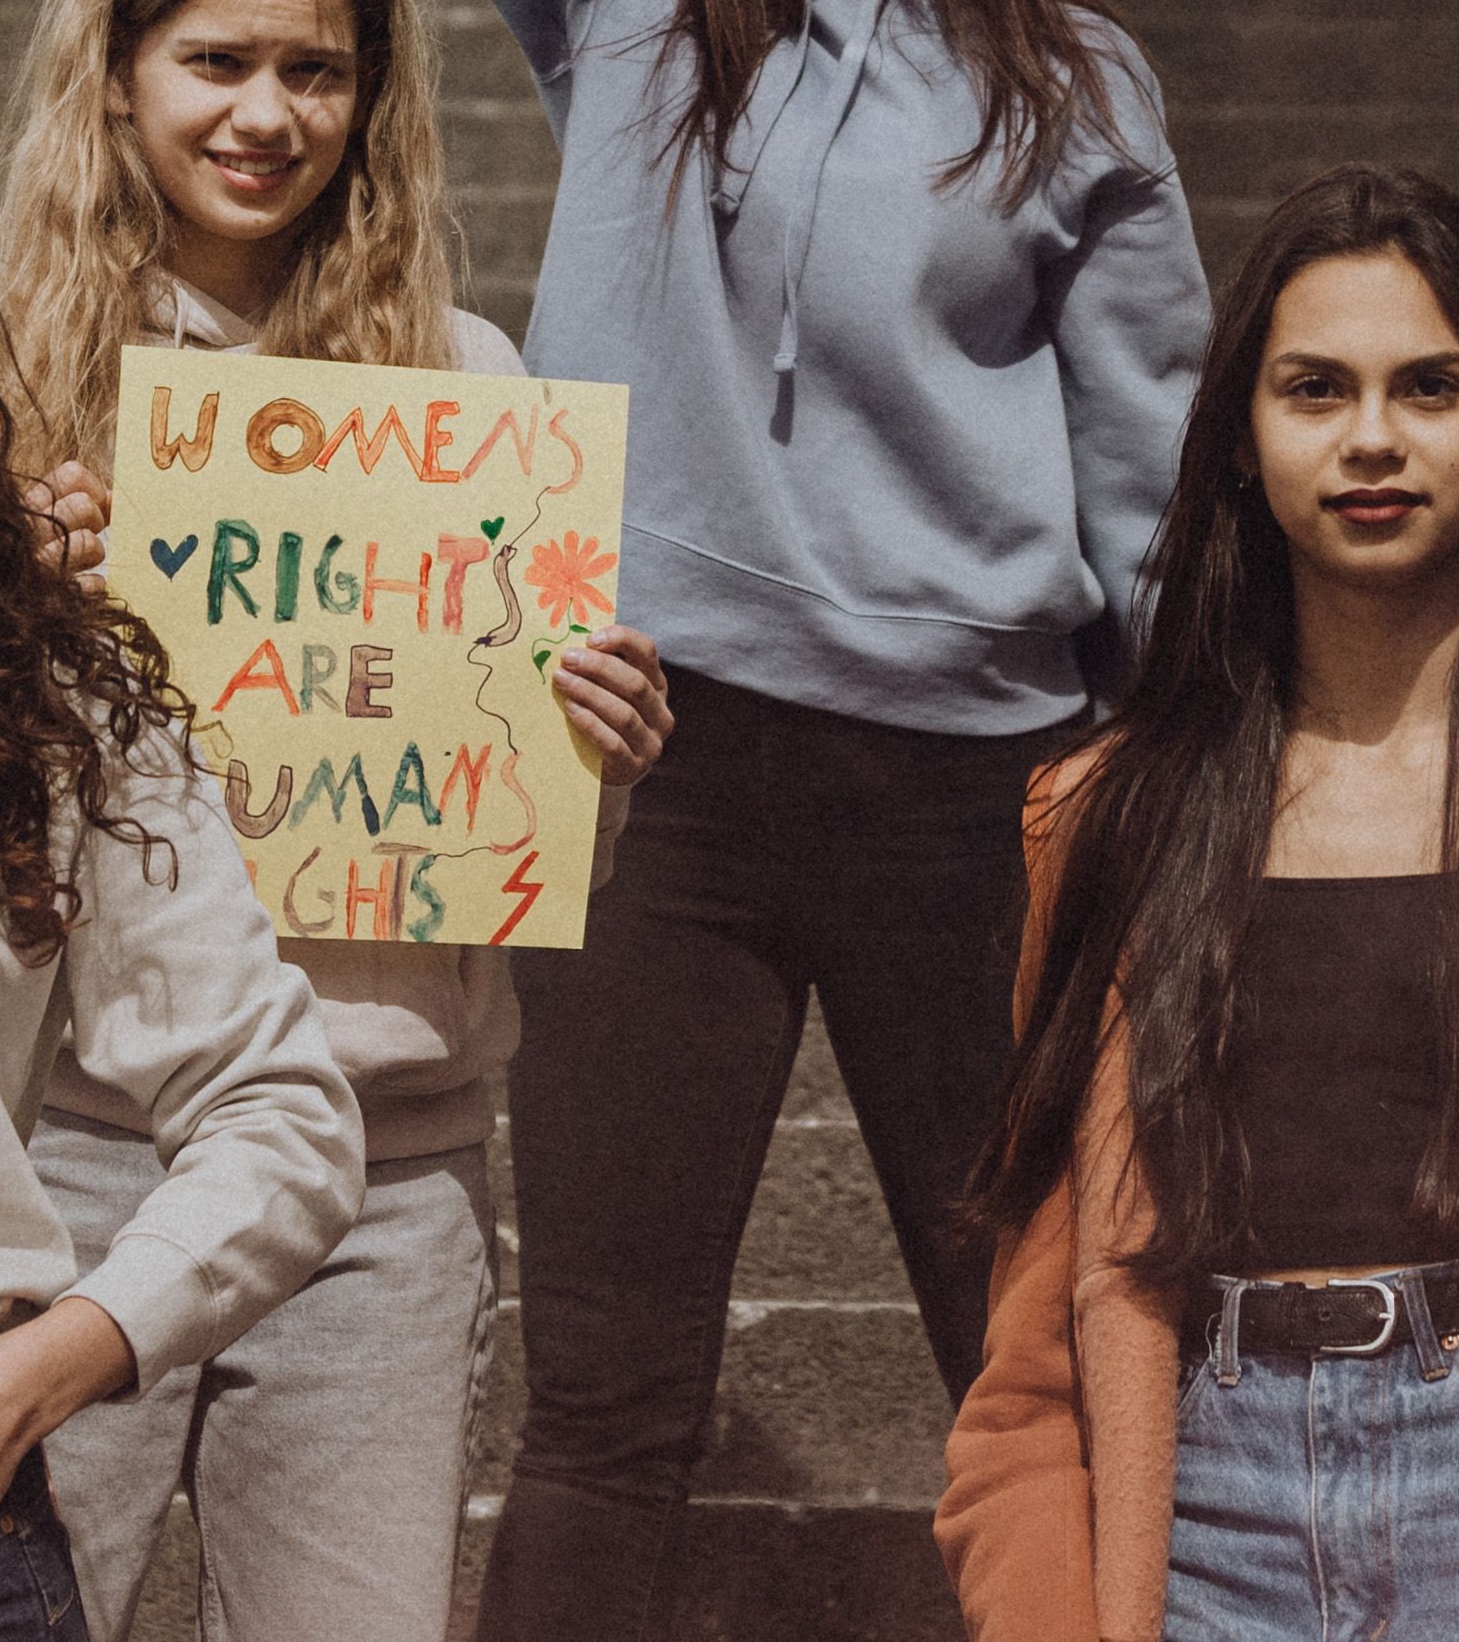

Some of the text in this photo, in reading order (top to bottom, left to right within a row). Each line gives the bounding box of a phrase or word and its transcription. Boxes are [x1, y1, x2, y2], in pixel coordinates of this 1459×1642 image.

[149, 380, 584, 495] WOMEN'S
[206, 518, 522, 648] RIGHTS
[210, 638, 394, 718] ARE
[223, 742, 537, 856] UMANS
[245, 841, 447, 944] GHTS
